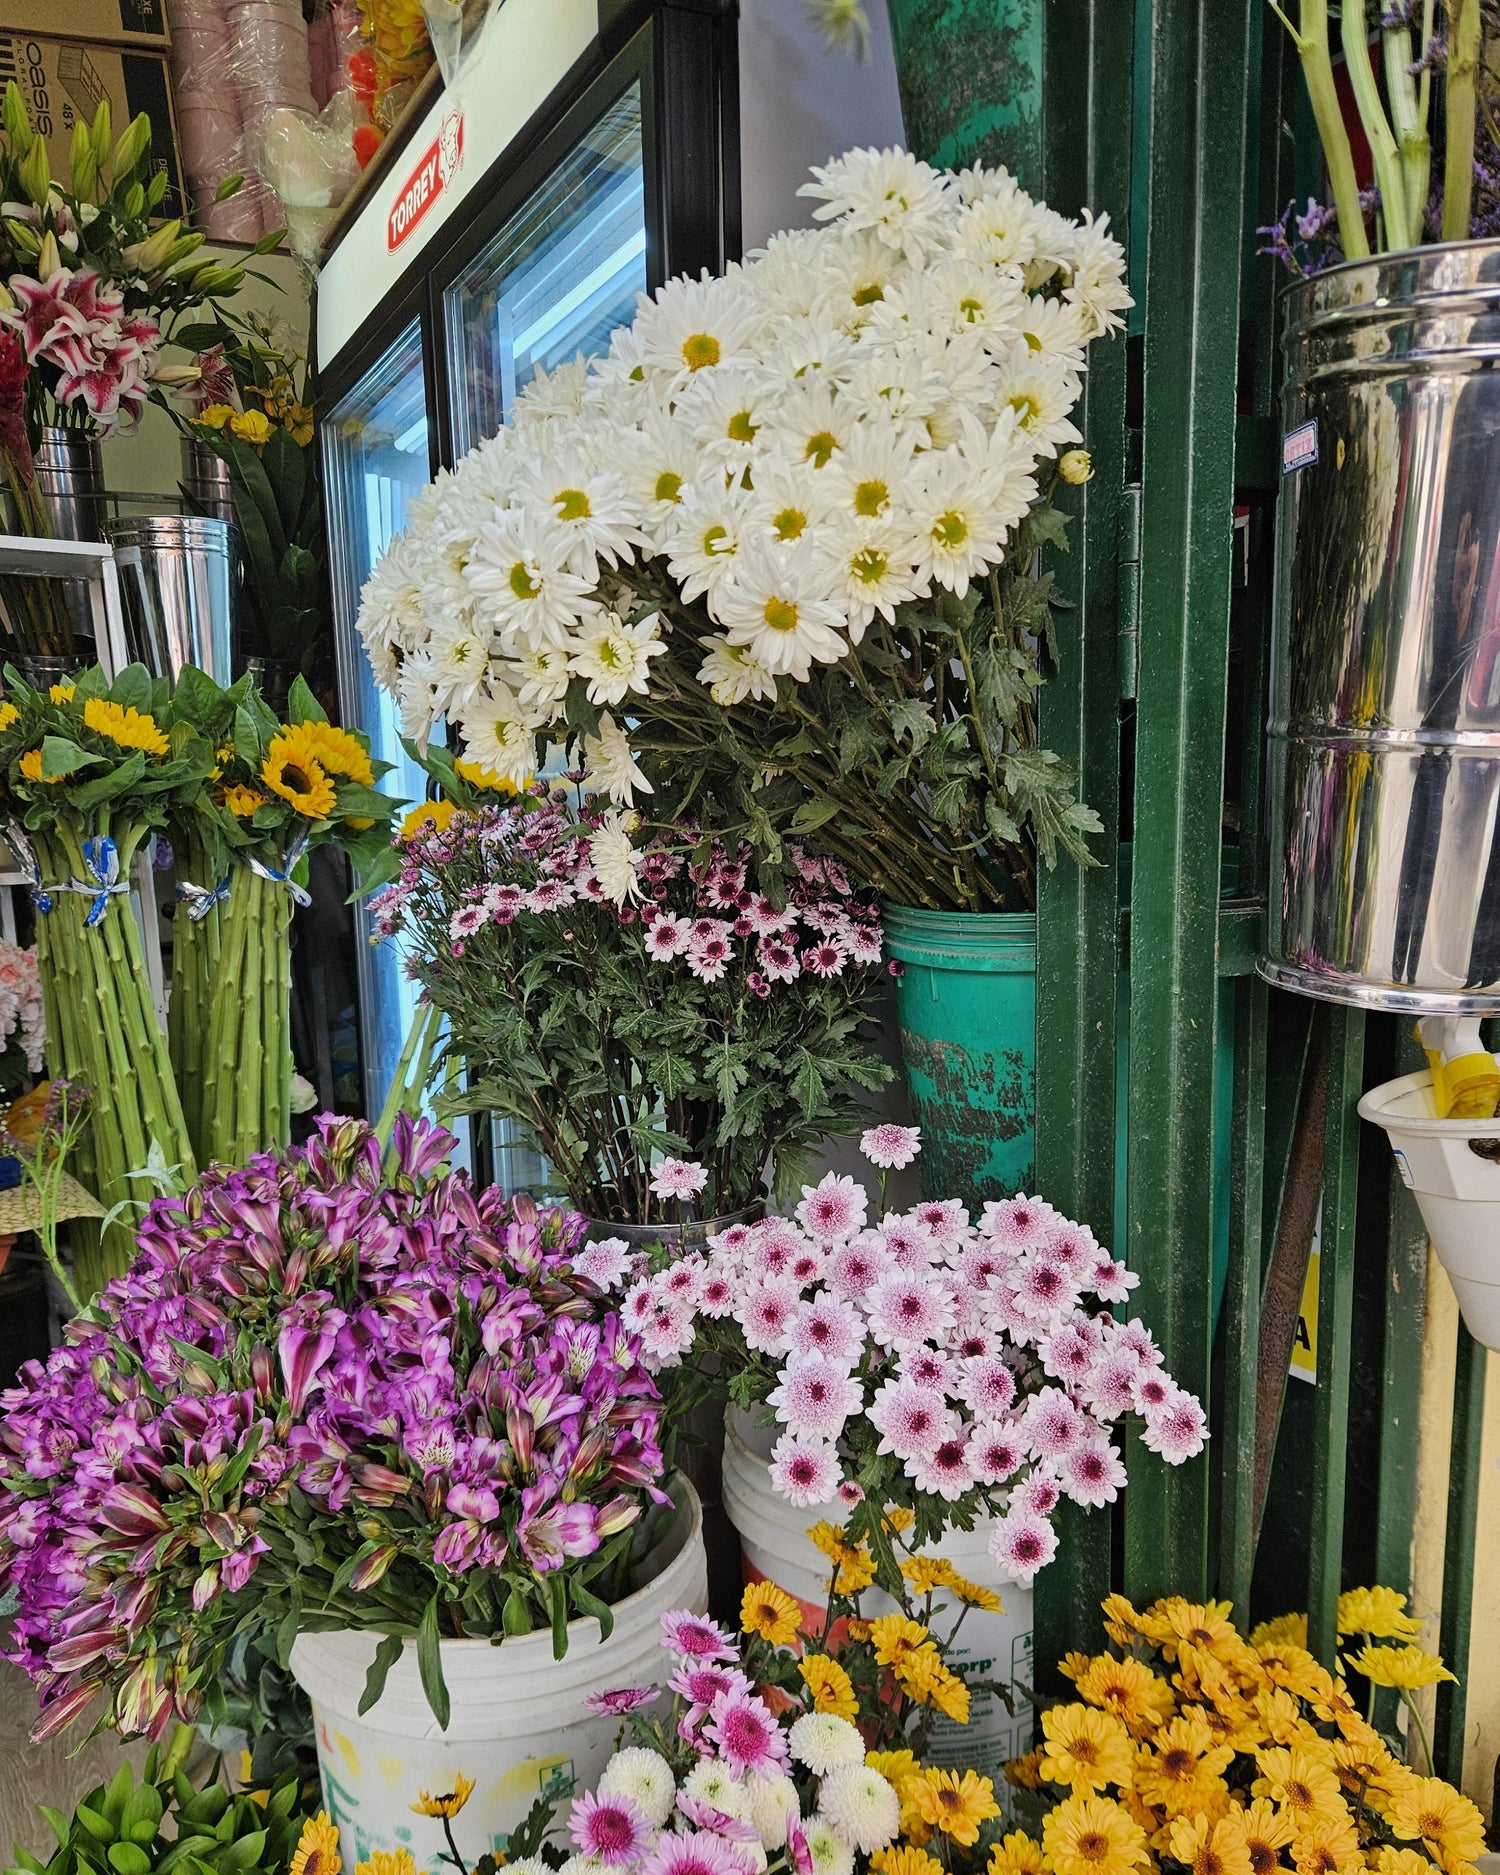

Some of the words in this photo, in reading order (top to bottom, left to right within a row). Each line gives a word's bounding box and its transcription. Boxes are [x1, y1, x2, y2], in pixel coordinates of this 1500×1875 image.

[143, 0, 153, 14] XE
[62, 103, 74, 118] 48
[158, 159, 172, 201] DEXE
[390, 154, 438, 242] TORREY
[1293, 1315, 1311, 1351] A
[956, 1647, 971, 1657] por:
[948, 1657, 992, 1674] corp
